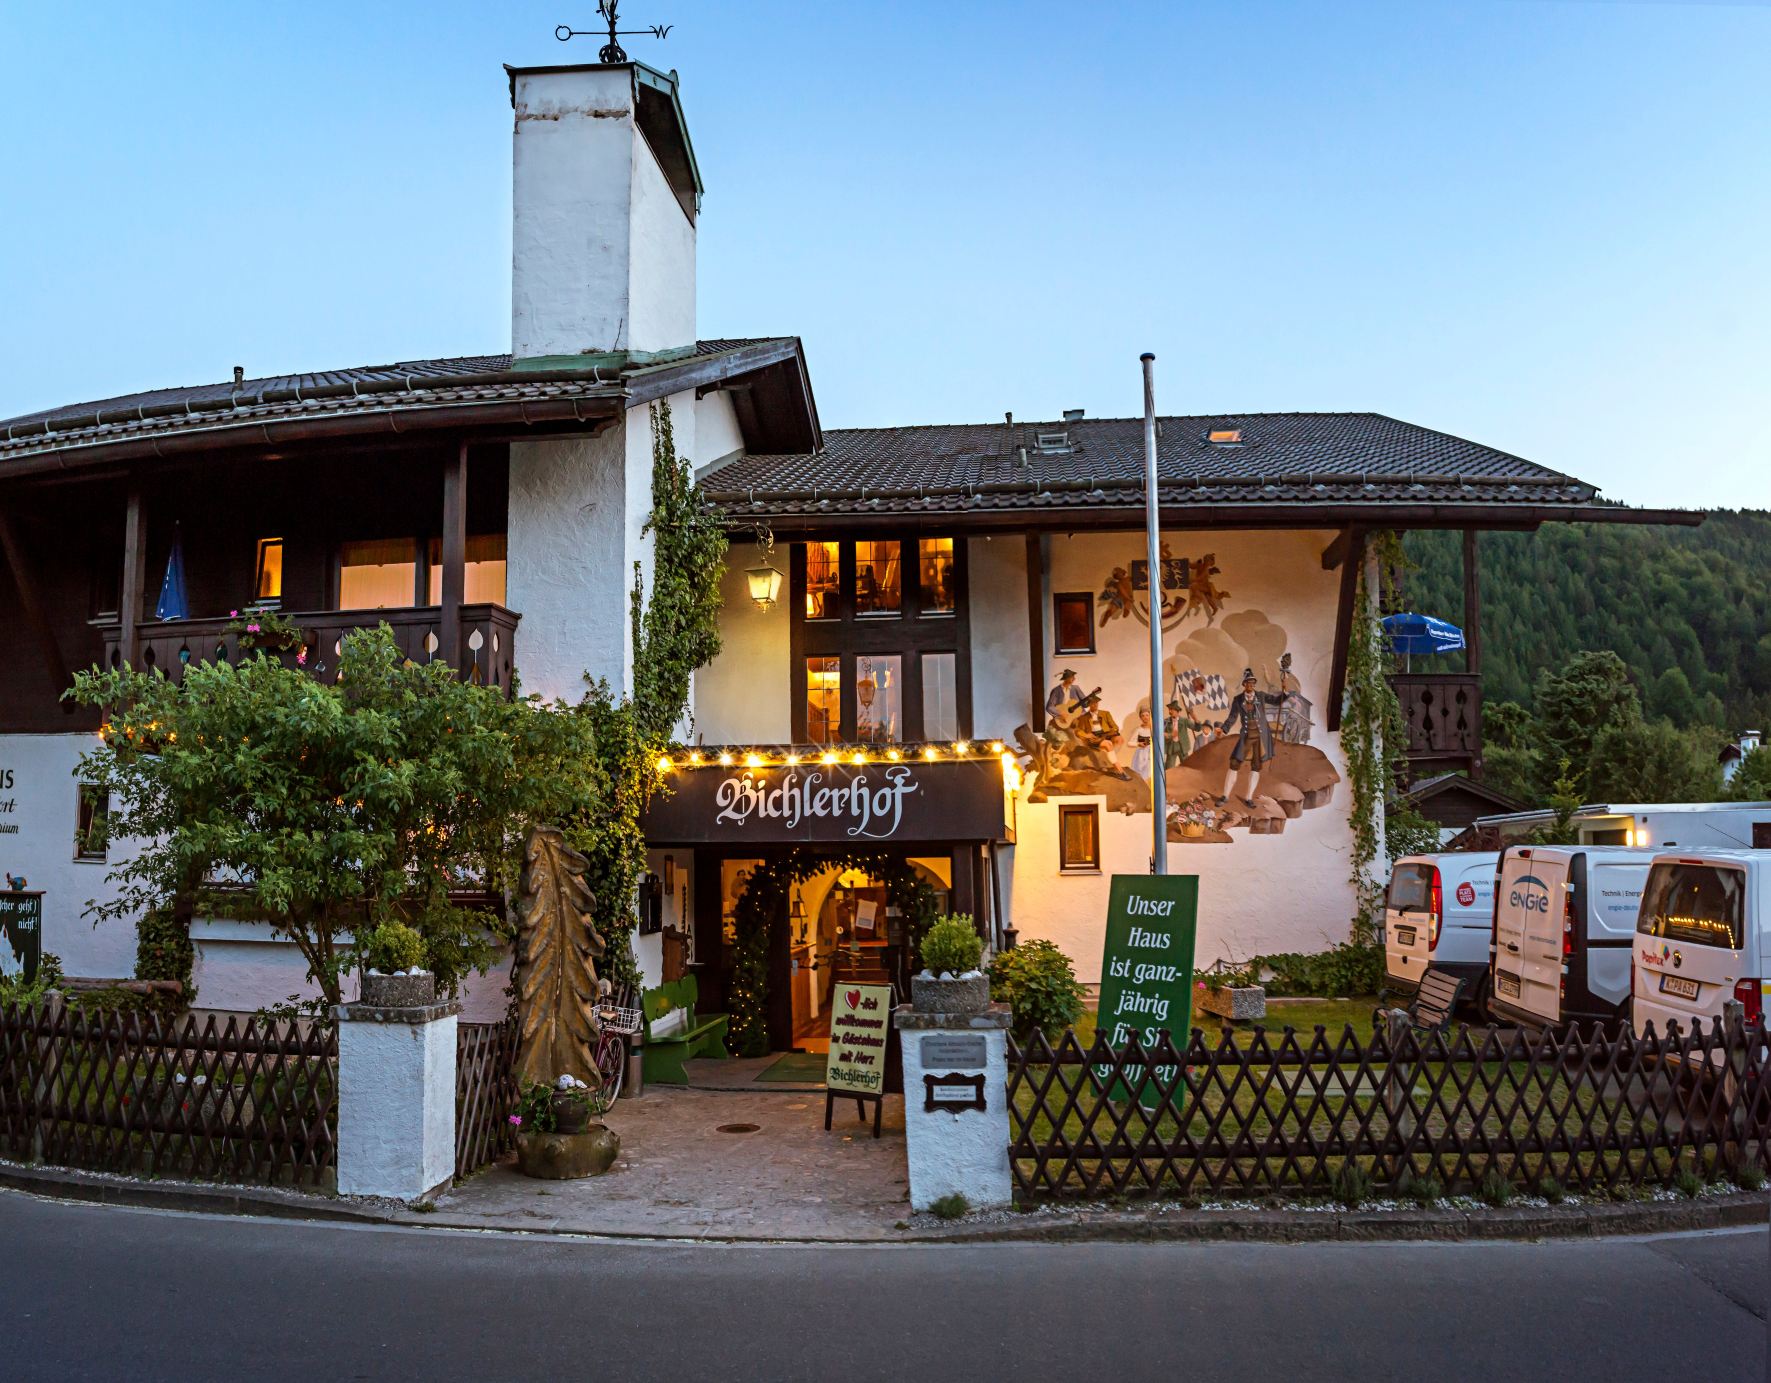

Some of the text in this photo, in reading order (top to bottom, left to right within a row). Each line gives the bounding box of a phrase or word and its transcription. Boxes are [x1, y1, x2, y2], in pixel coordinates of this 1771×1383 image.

[716, 766, 919, 838] Bichlerhof
[1126, 895, 1175, 917] Unser
[1127, 927, 1171, 949] Haus
[1110, 956, 1182, 984] ist ganz-
[1113, 989, 1170, 1021] jährig
[1111, 1022, 1168, 1050] fü Si
[854, 1051, 875, 1065] Herz
[830, 1066, 881, 1090] Bichlerhof
